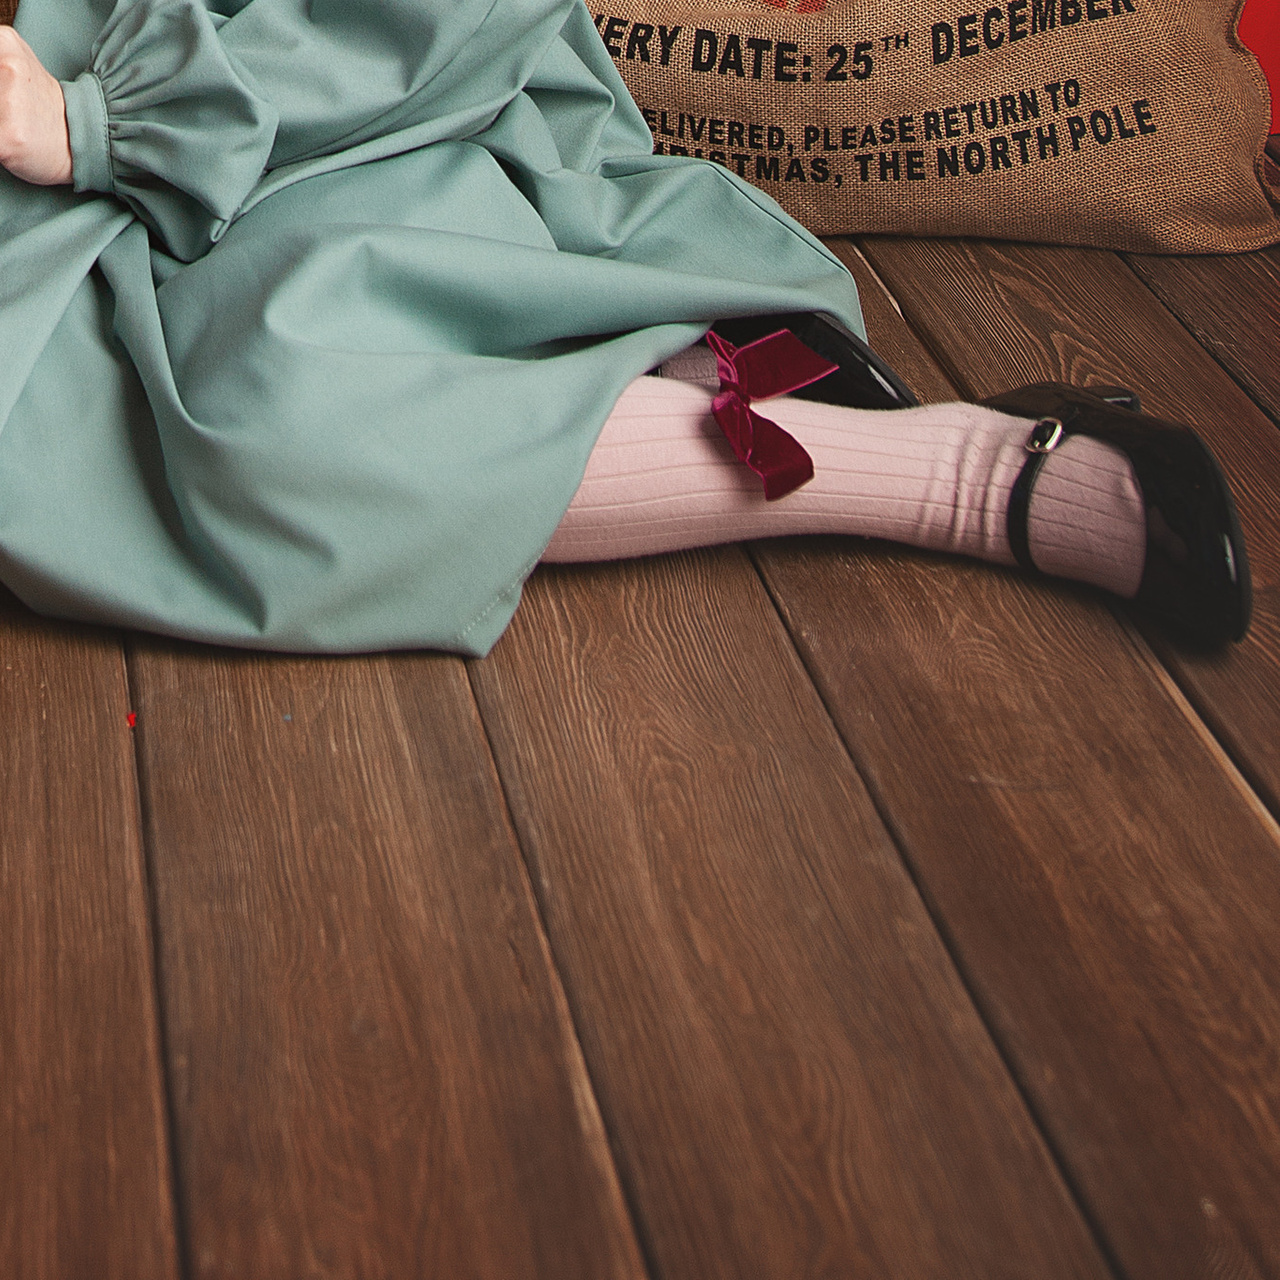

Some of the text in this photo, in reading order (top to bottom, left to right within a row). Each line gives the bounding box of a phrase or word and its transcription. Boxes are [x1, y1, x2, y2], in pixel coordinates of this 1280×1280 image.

[692, 28, 812, 82] DATE:
[804, 114, 915, 152] PLEASE
[924, 89, 1040, 141] RETURN
[1044, 78, 1081, 114] TO
[855, 150, 926, 183] THE
[937, 123, 1060, 179] NORTH
[1067, 98, 1157, 151] POLE
